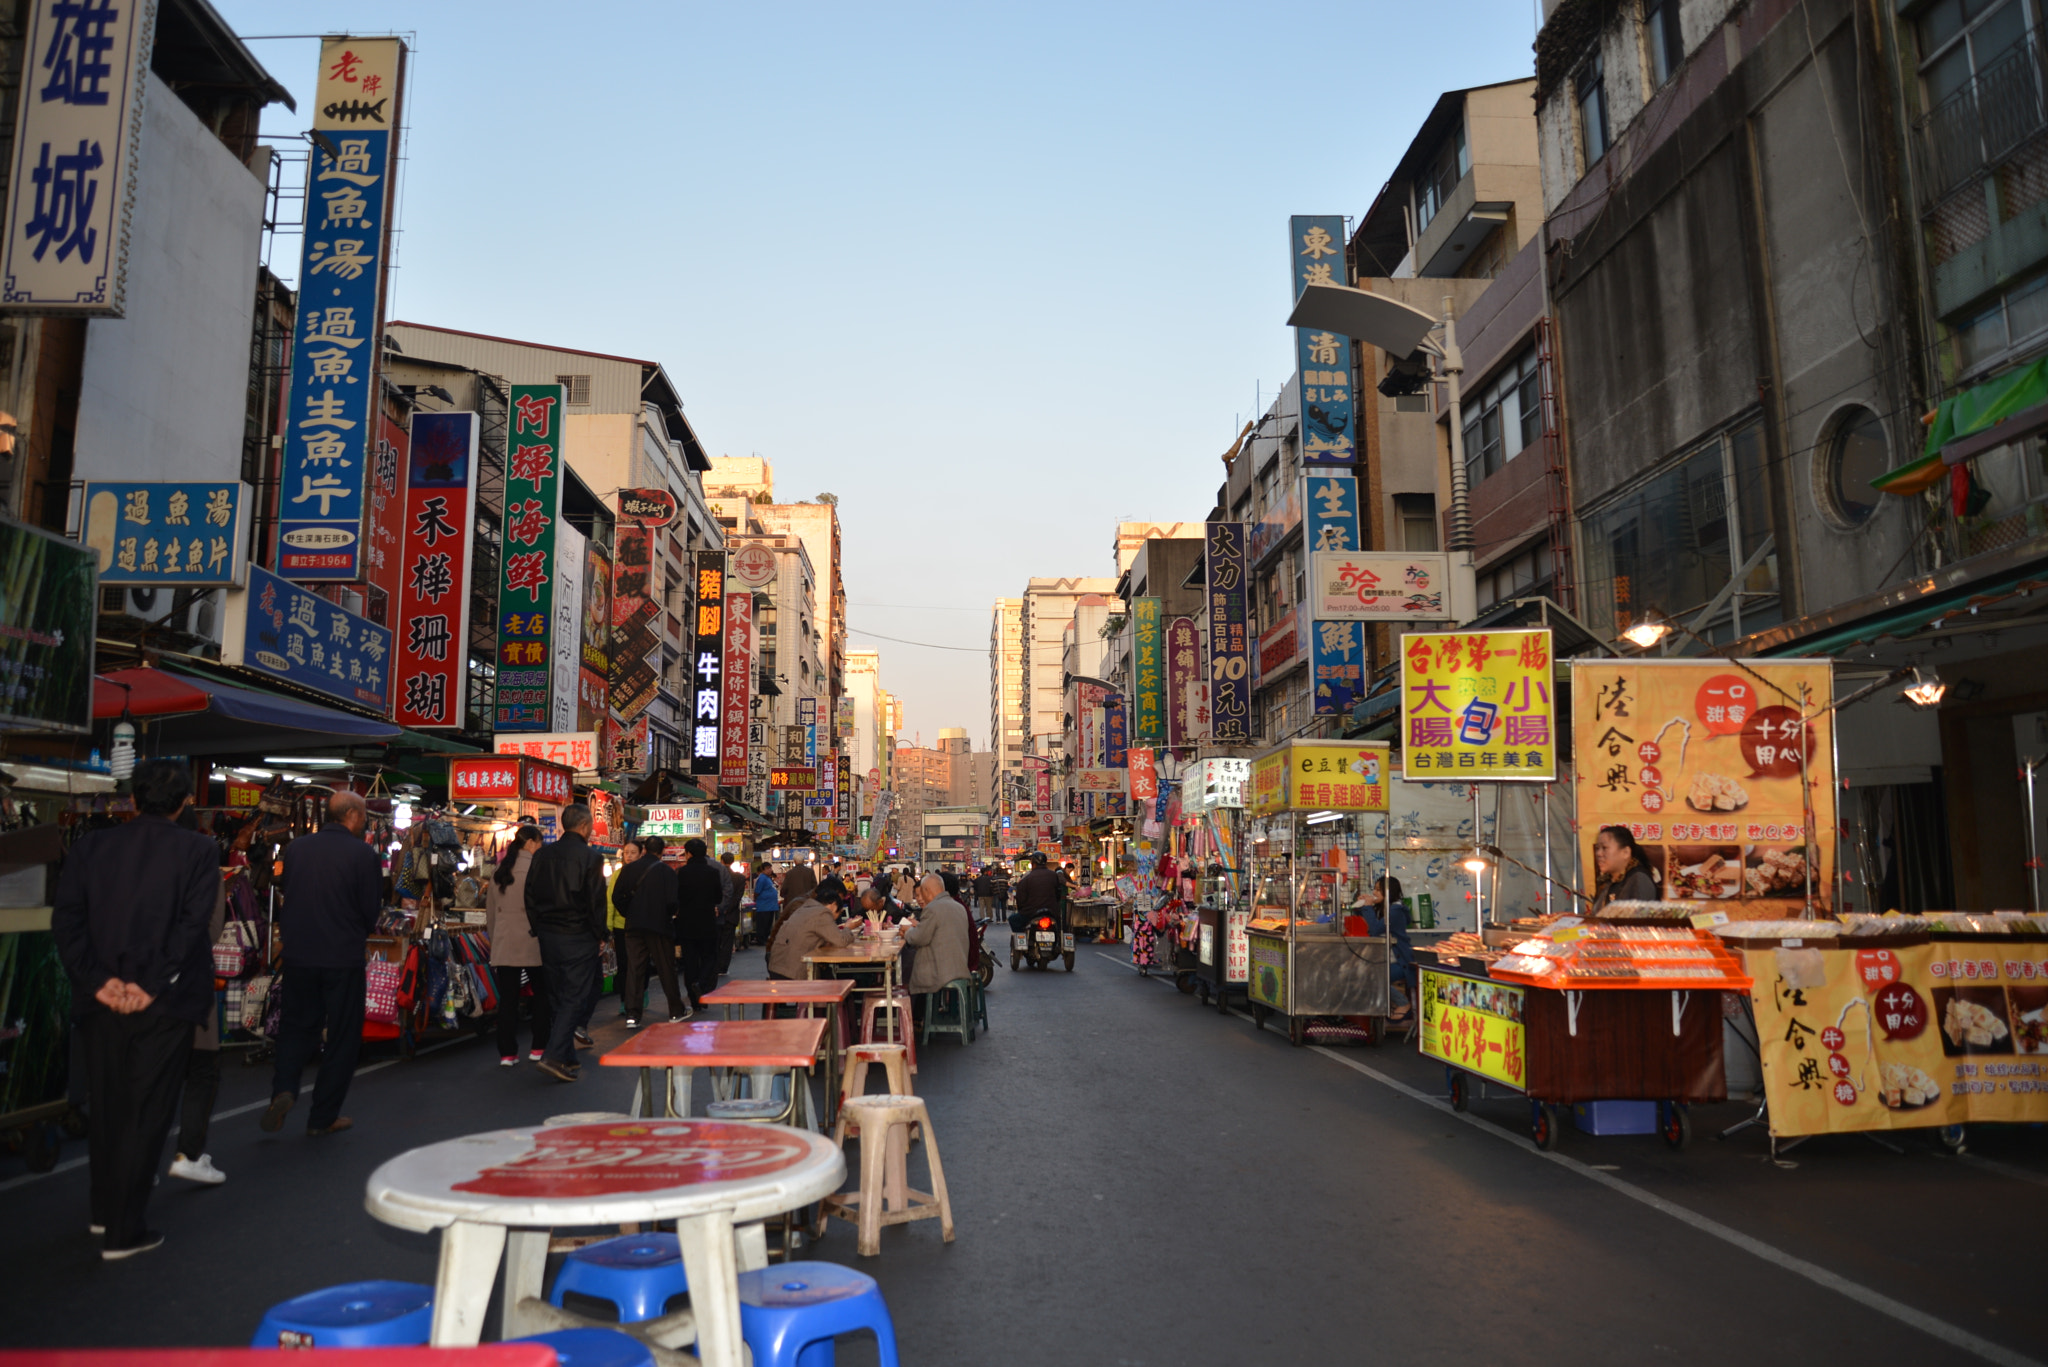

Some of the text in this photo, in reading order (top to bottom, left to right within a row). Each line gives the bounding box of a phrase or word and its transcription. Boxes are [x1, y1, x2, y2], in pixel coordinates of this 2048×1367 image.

[329, 51, 382, 96] 老牌
[124, 489, 232, 527] 過魚湯
[507, 394, 556, 603] 阿輝海鮮
[118, 536, 229, 576] 過魚生魚片
[286, 534, 351, 543] 野生深海石斑魚
[1211, 525, 1241, 590] 大力
[288, 595, 386, 662] 過魚湯
[404, 497, 458, 722] 禾樺珊瑚
[504, 614, 545, 634] 老店
[503, 643, 544, 664] 實價
[695, 569, 721, 757] 豬腳 牛肉麵
[1136, 601, 1160, 734] 精芳茗茶商行
[1407, 633, 1547, 674] 台灣第一腸
[725, 596, 751, 759] 東東迷你火鍋燒肉
[1707, 685, 1746, 699] 一口
[498, 708, 545, 723] 請上二樓
[1409, 679, 1453, 747] 大腸
[1460, 696, 1497, 745] 包
[1503, 676, 1550, 746] 小腸
[1706, 705, 1746, 723] 甜蜜
[614, 738, 639, 771] 料理
[1132, 754, 1153, 793] 泳衣
[1414, 751, 1544, 768] 台灣百年美食
[457, 771, 516, 787] 虱目魚米粉
[1300, 783, 1382, 808] 無骨雞腳凍
[1640, 744, 1662, 811] 牛軋糖
[1600, 824, 1661, 840] 香脆
[1440, 1007, 1522, 1082] 台灣第一腸
[1822, 1029, 1854, 1102] 牛軋糖
